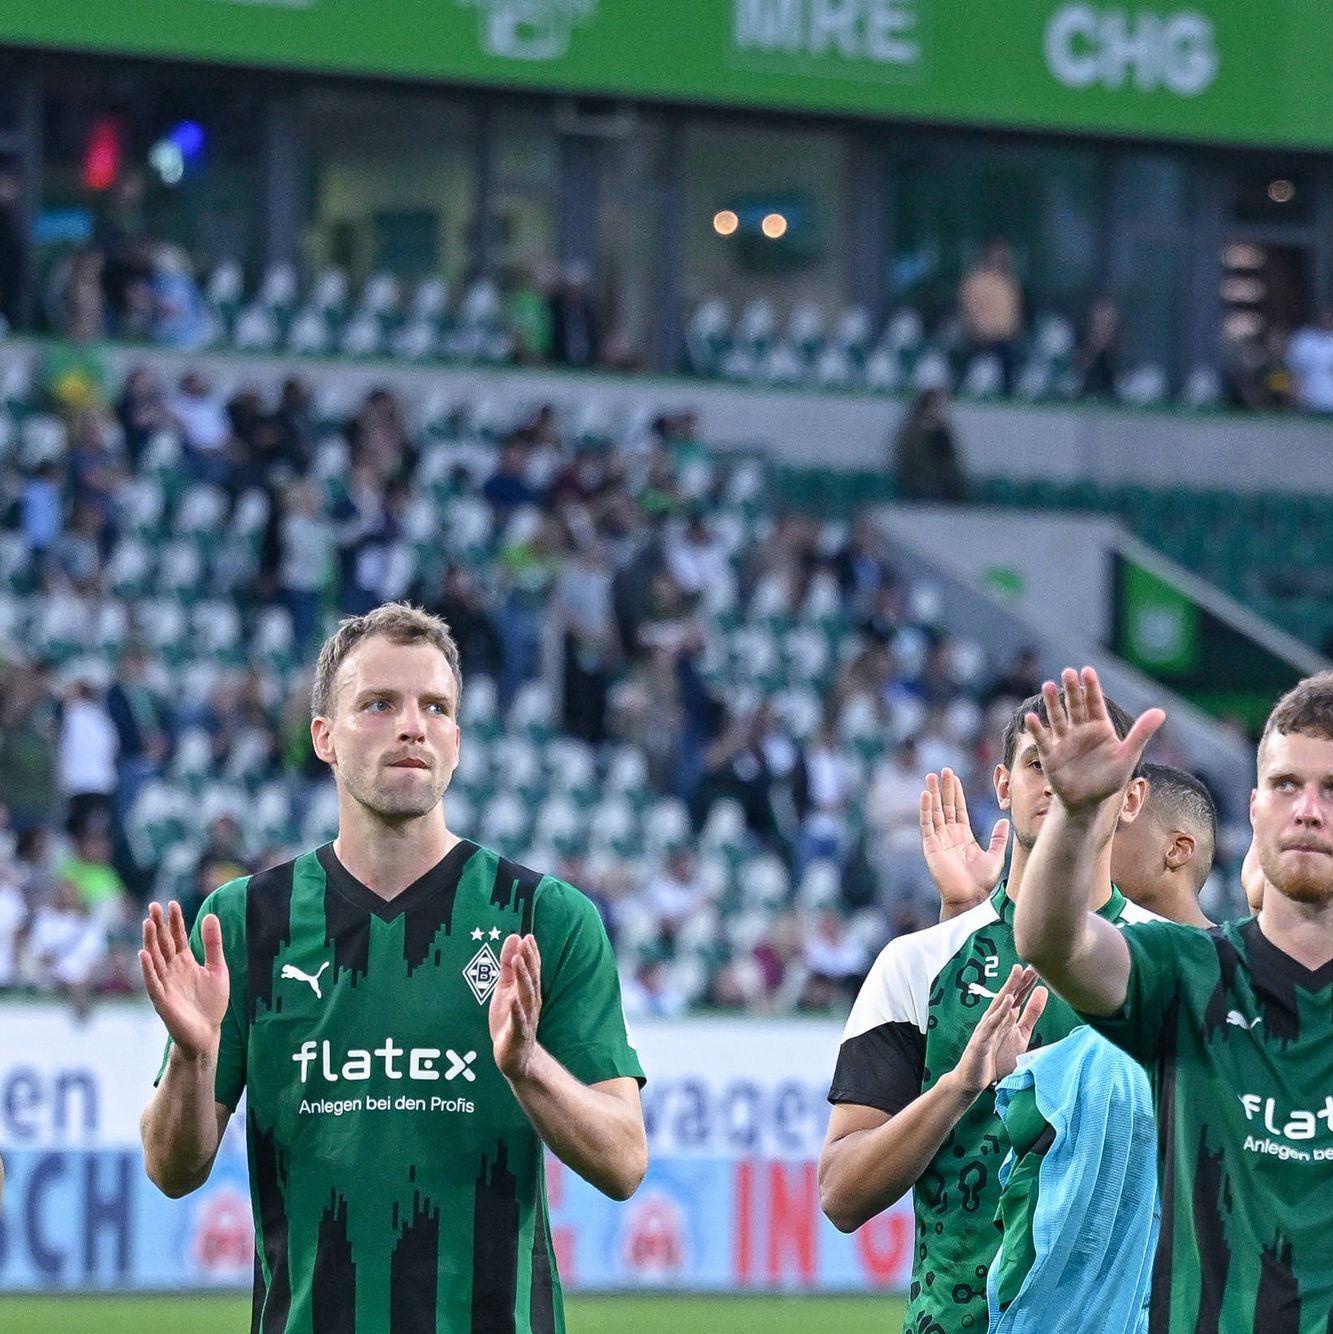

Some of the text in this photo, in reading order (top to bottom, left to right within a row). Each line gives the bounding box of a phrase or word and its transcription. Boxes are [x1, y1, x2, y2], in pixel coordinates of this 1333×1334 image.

[1044, 4, 1216, 96] CHG
[292, 1037, 477, 1083] flatex
[299, 1095, 475, 1116] Anlegen bei den Profis
[1243, 1136, 1310, 1161] Anlegen
